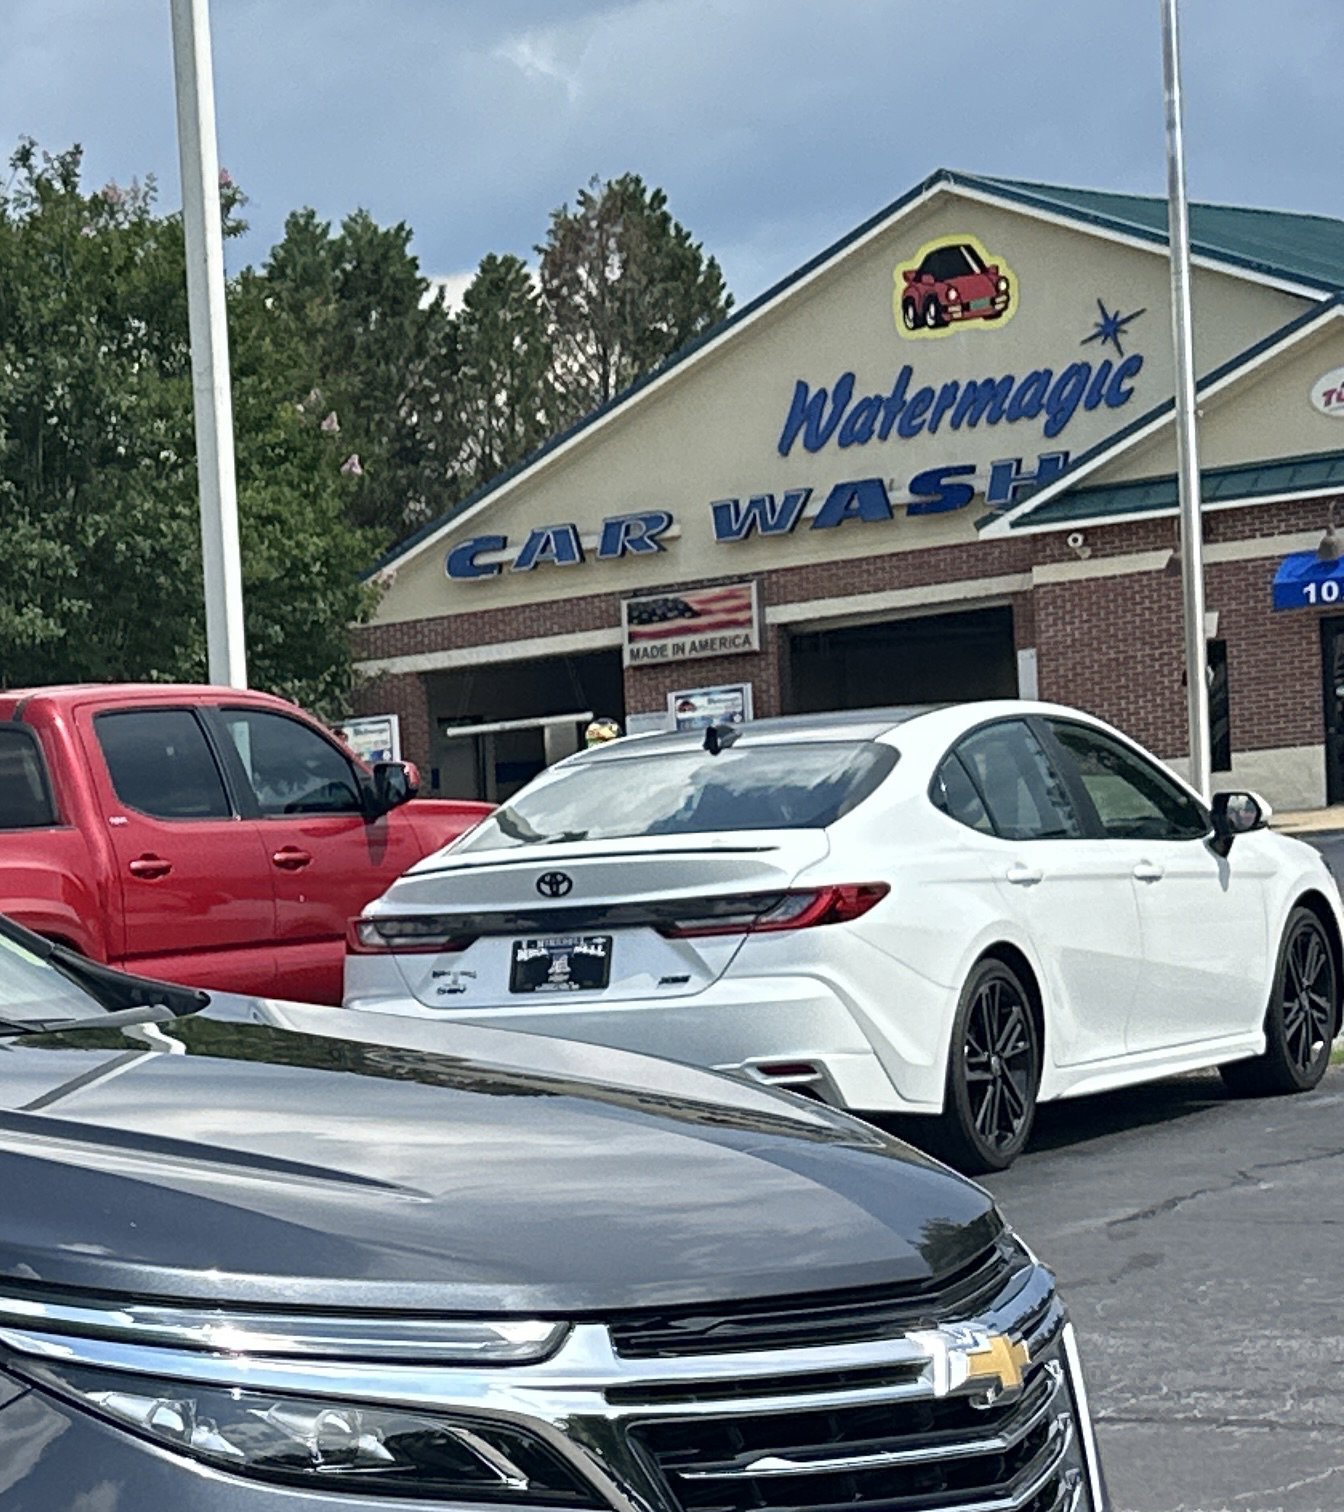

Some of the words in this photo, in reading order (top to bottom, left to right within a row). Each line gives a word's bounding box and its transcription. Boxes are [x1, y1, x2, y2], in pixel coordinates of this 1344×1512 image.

[778, 354, 1144, 456] Watermagic
[444, 510, 674, 581] CAR
[710, 451, 1072, 542] WASH
[630, 644, 668, 661] MADE
[672, 642, 685, 656] IN
[688, 634, 752, 652] AMERICA
